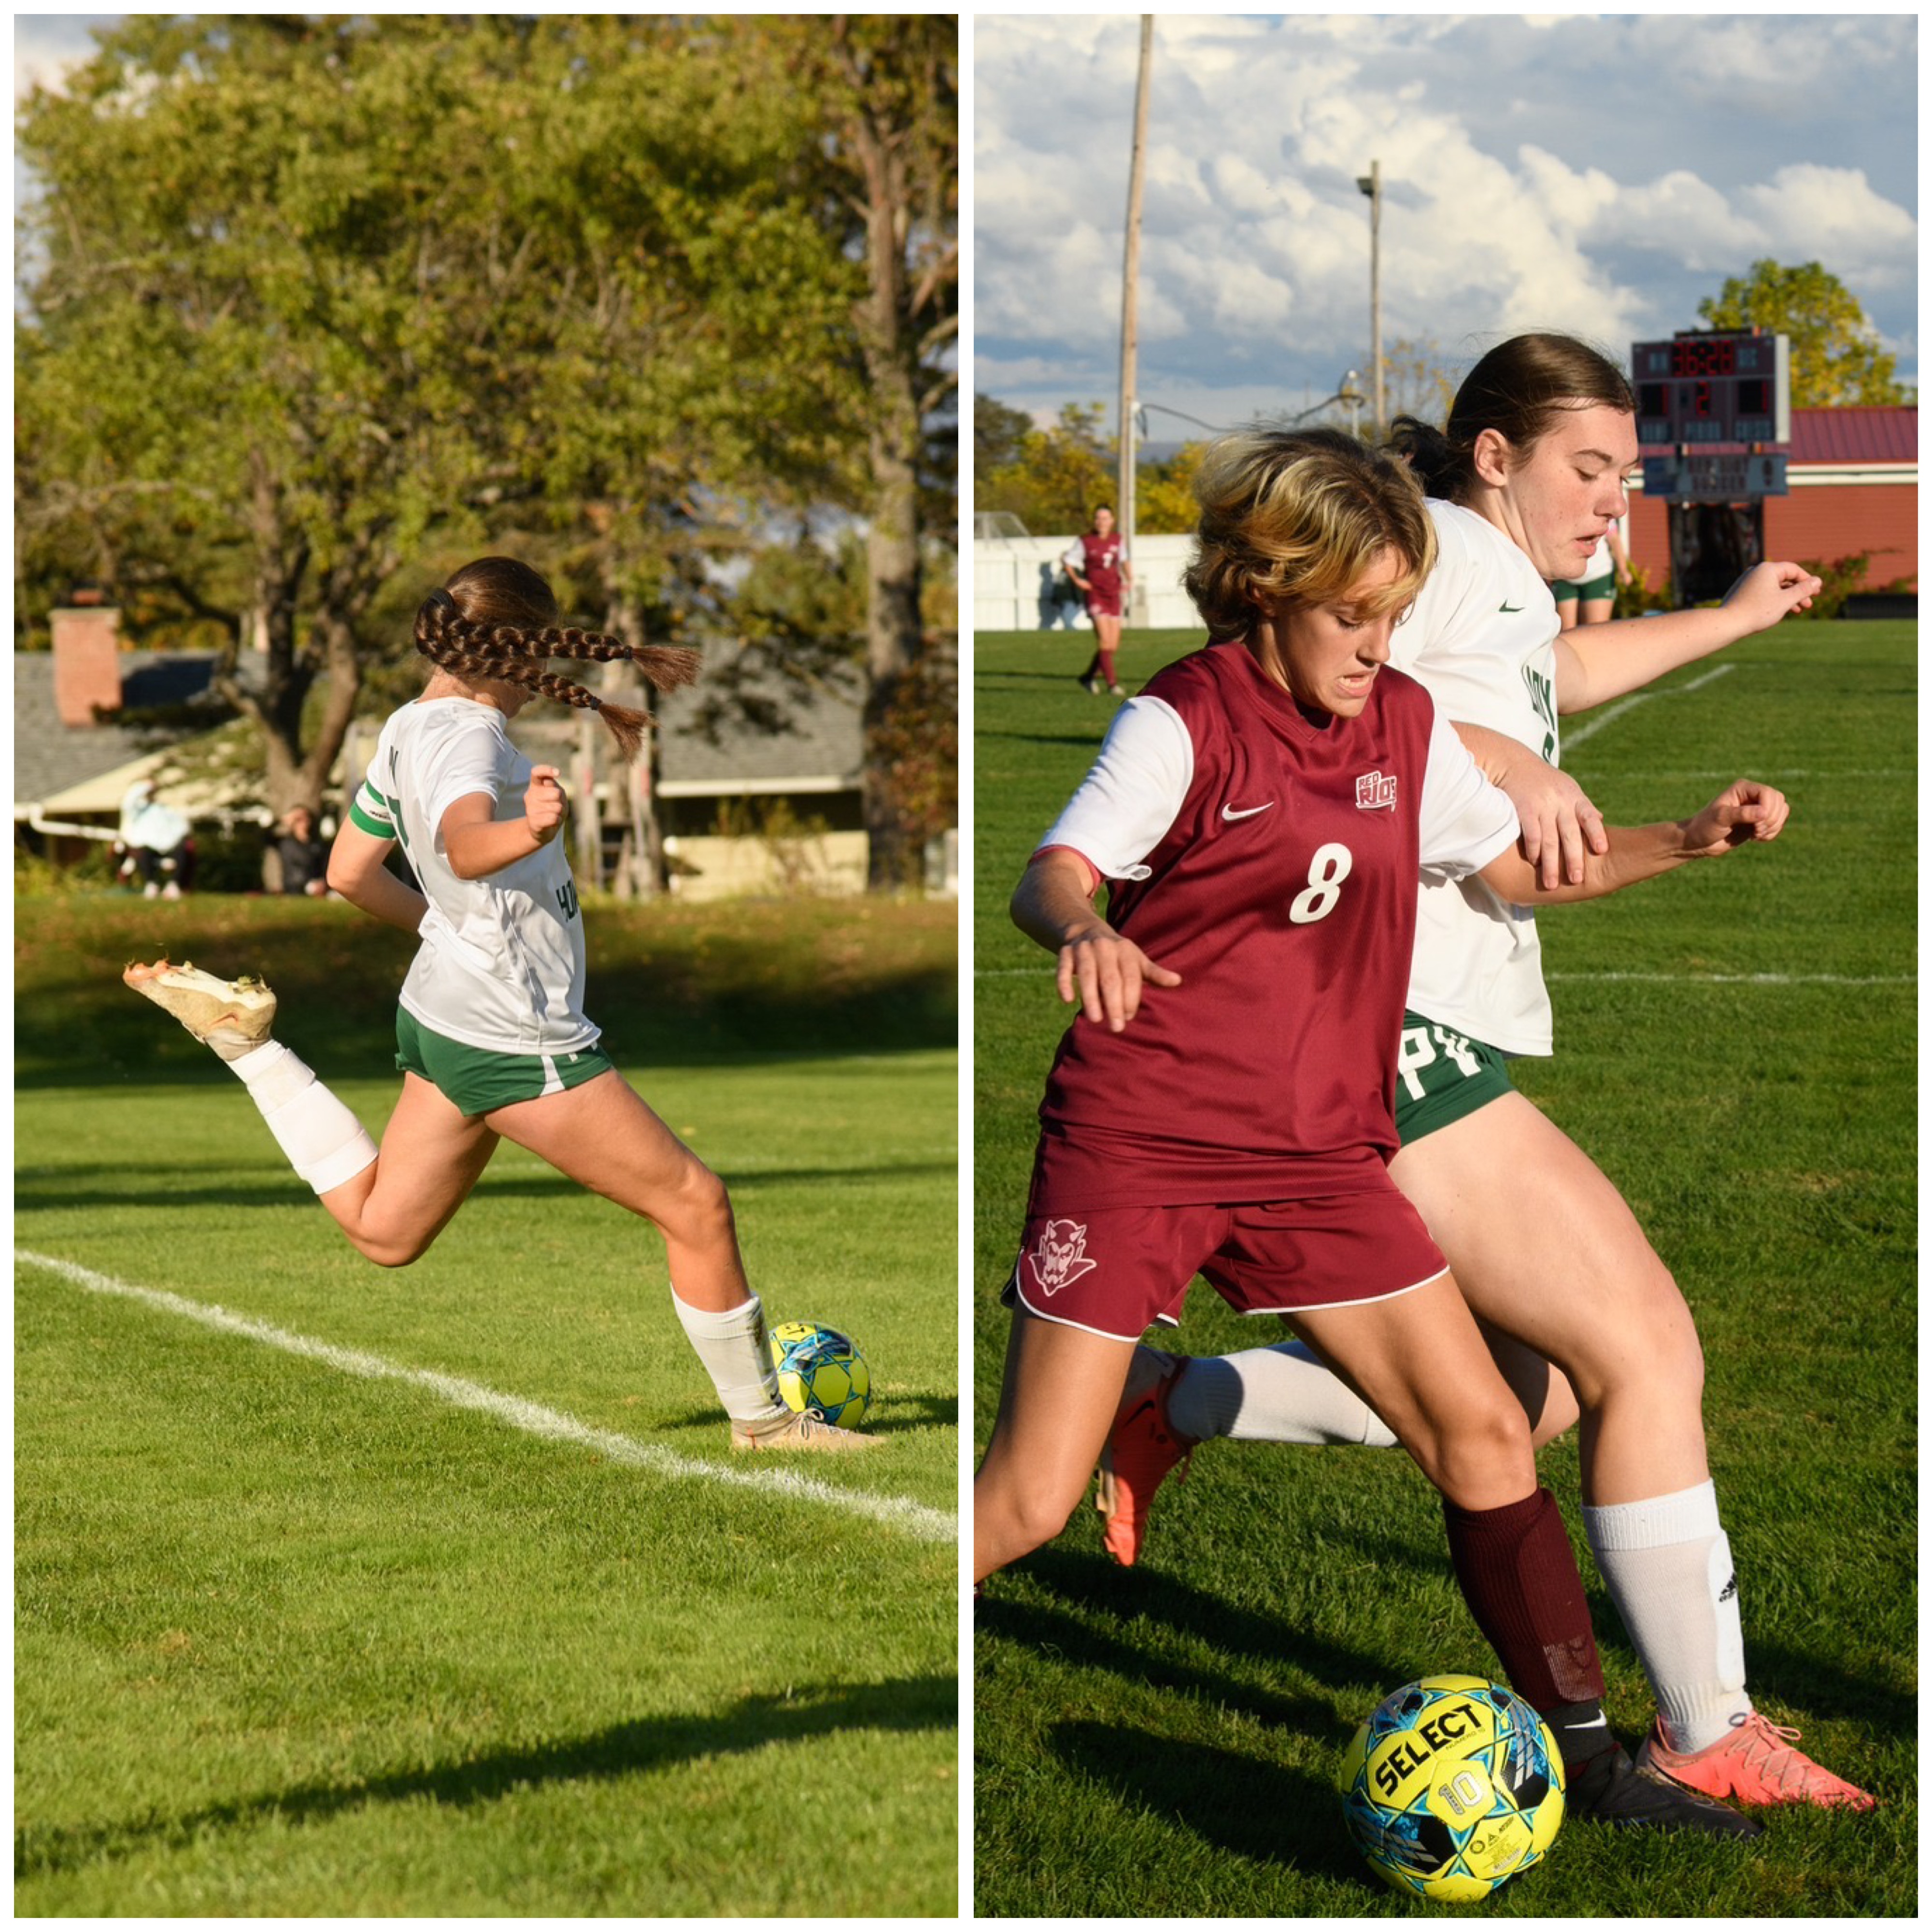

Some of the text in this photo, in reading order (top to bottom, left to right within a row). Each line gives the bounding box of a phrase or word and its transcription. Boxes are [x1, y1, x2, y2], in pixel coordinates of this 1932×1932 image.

[1696, 382, 1710, 417] 2
[1358, 773, 1378, 788] RED
[1289, 842, 1352, 923] 8
[1375, 1704, 1482, 1798] SELECT
[1438, 1770, 1482, 1815] 10
